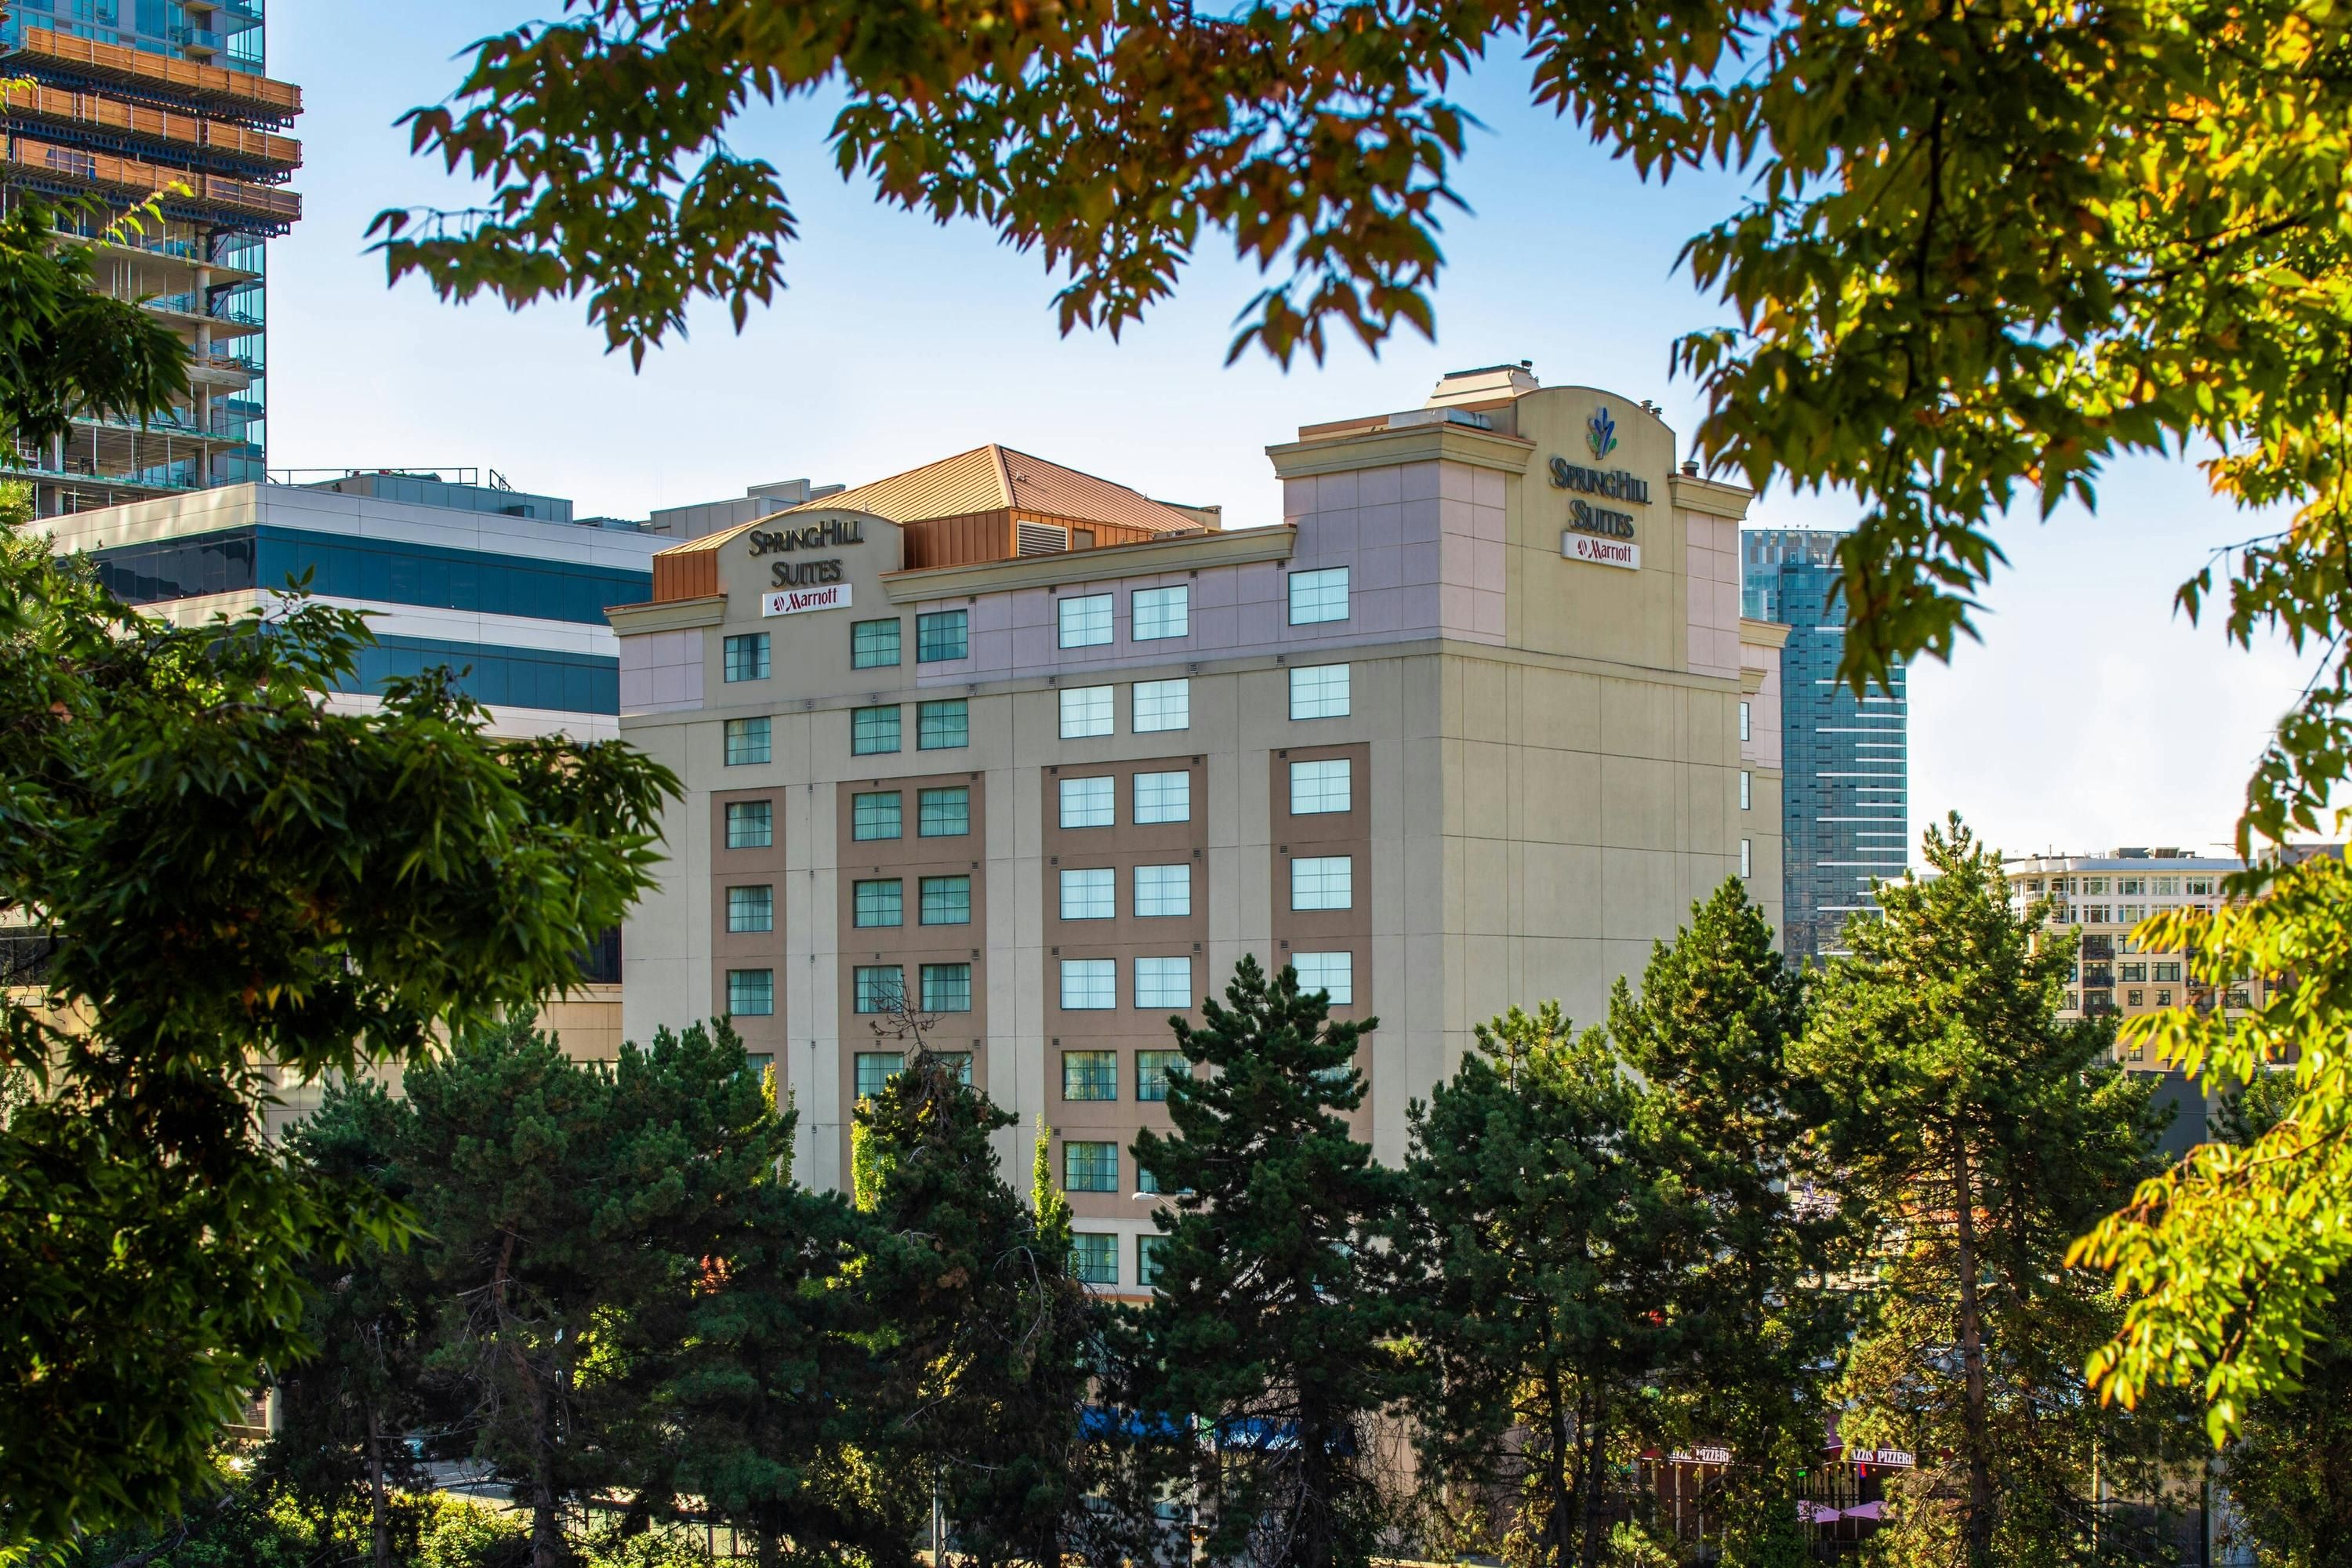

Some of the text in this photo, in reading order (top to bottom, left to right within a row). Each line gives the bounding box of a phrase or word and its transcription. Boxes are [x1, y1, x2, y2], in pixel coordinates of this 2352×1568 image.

[1588, 539, 1631, 562] Marriott
[786, 588, 837, 612] Marriott
[1695, 1448, 1731, 1462] PIZZERI
[1877, 1450, 1915, 1465] PIZZERI
